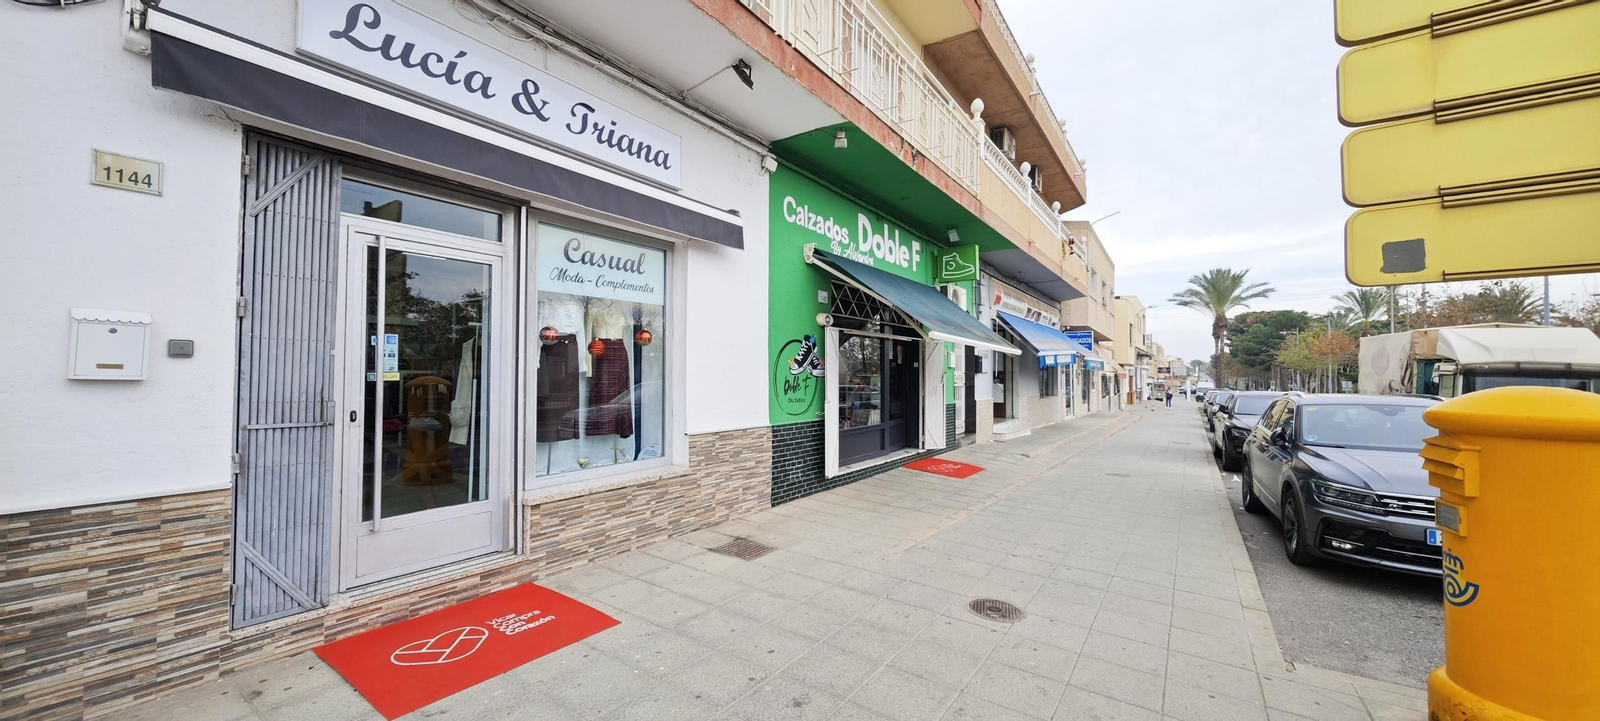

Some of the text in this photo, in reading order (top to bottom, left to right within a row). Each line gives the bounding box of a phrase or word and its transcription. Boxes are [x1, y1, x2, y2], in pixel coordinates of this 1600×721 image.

[329, 3, 672, 170] Lucía & Triana
[103, 166, 152, 188] 1144
[783, 196, 849, 244] Calzados
[858, 213, 920, 271] Doble F
[563, 238, 645, 274] Casual
[550, 267, 586, 284] Moda
[595, 274, 655, 293] Complementos
[485, 613, 516, 625] Vicar
[493, 610, 541, 629] Compra
[505, 615, 556, 635] Corazón
